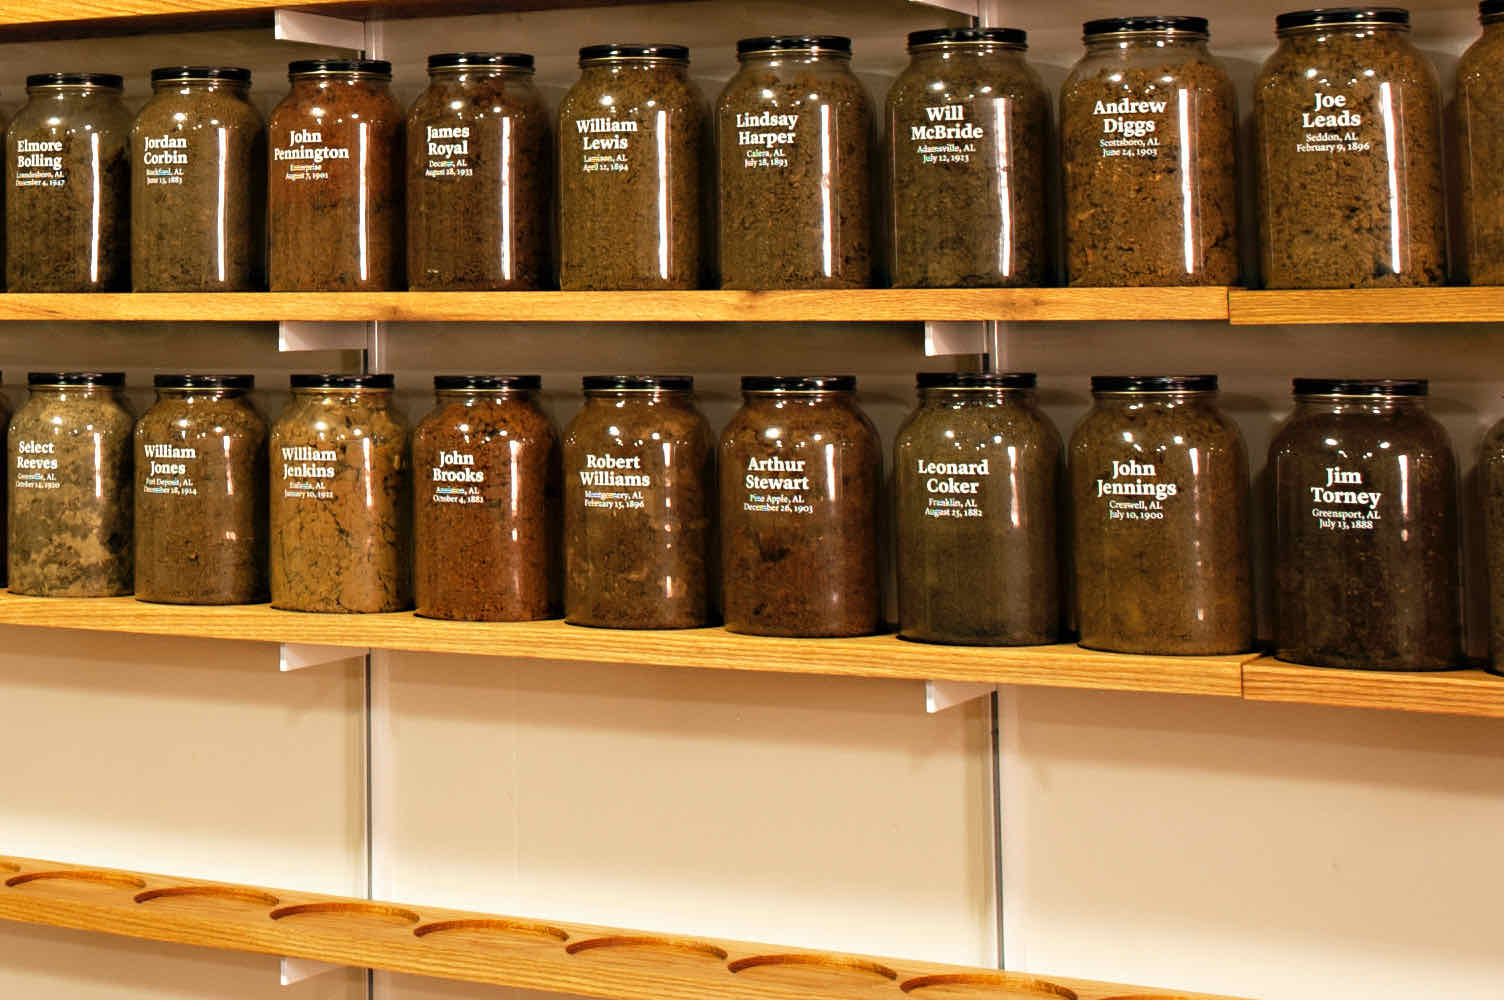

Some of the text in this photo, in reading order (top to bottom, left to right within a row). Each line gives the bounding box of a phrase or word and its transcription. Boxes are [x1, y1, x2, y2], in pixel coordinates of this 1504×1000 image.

[1093, 98, 1167, 116] Andrew
[1314, 92, 1346, 111] Joe
[926, 105, 963, 121] Will
[1302, 110, 1361, 128] Leads
[576, 118, 638, 134] William
[736, 113, 798, 134] Lindsay
[911, 123, 984, 140] McBride
[1104, 117, 1156, 138] Diggs
[289, 130, 322, 144] John
[426, 125, 470, 140] James
[738, 130, 796, 149] Harper
[1306, 131, 1358, 143] Seddon, AL
[17, 138, 63, 153] Elmore
[144, 134, 187, 150] Jordan
[427, 140, 468, 158] Royal
[583, 134, 628, 150] Lewis
[1296, 142, 1333, 154] February
[1347, 140, 1370, 152] 1896
[17, 153, 62, 171] Bolling
[143, 149, 188, 165] Corbin
[274, 145, 349, 163] Pennington
[18, 440, 54, 455] Select
[144, 444, 196, 459] William
[281, 447, 336, 462] William
[16, 456, 58, 470] Reeves
[439, 451, 474, 468] John
[586, 454, 640, 469] Robert
[748, 456, 805, 472] Arthur
[917, 459, 989, 476] Leonard
[150, 460, 186, 476] Jones
[283, 463, 335, 479] Jenkins
[433, 467, 484, 483] Brooks
[1112, 460, 1156, 478] John
[1326, 467, 1362, 485] Jim
[580, 471, 650, 487] Williams
[745, 474, 809, 491] Stewart
[926, 477, 979, 494] Coker
[1097, 479, 1177, 500] Jennings
[1310, 487, 1381, 508] Torney
[1312, 508, 1381, 520] Greensport, AL
[1319, 518, 1336, 530] July
[1351, 518, 1373, 530] 1888
